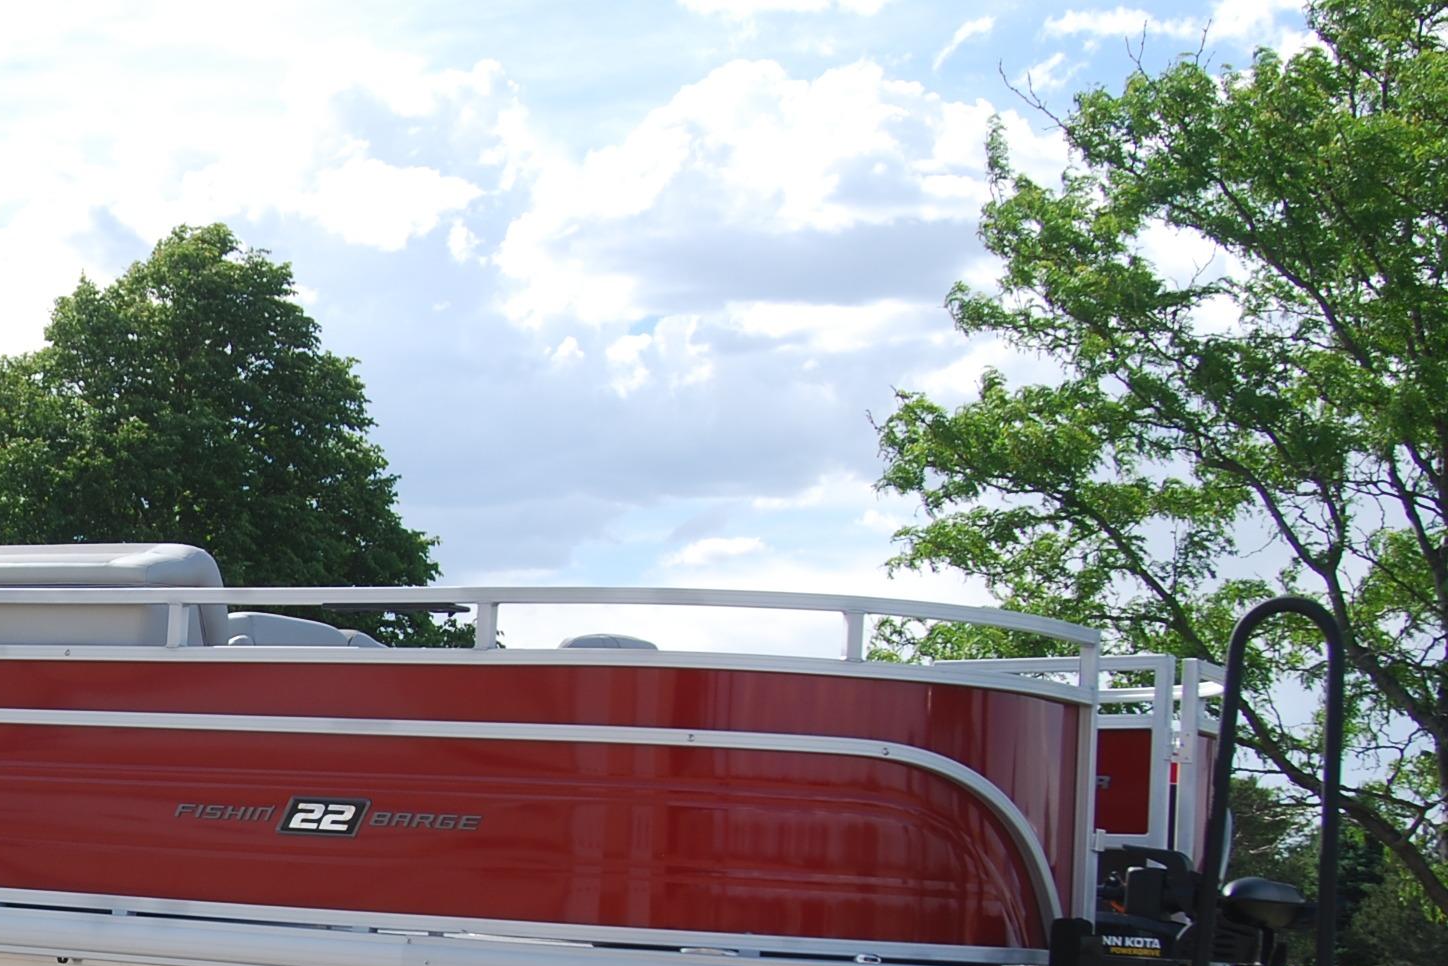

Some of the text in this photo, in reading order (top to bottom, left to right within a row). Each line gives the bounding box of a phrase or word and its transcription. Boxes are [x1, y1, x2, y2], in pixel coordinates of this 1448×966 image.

[289, 802, 356, 831] 22
[369, 812, 482, 830] BARGE
[1125, 936, 1161, 949] KOTA
